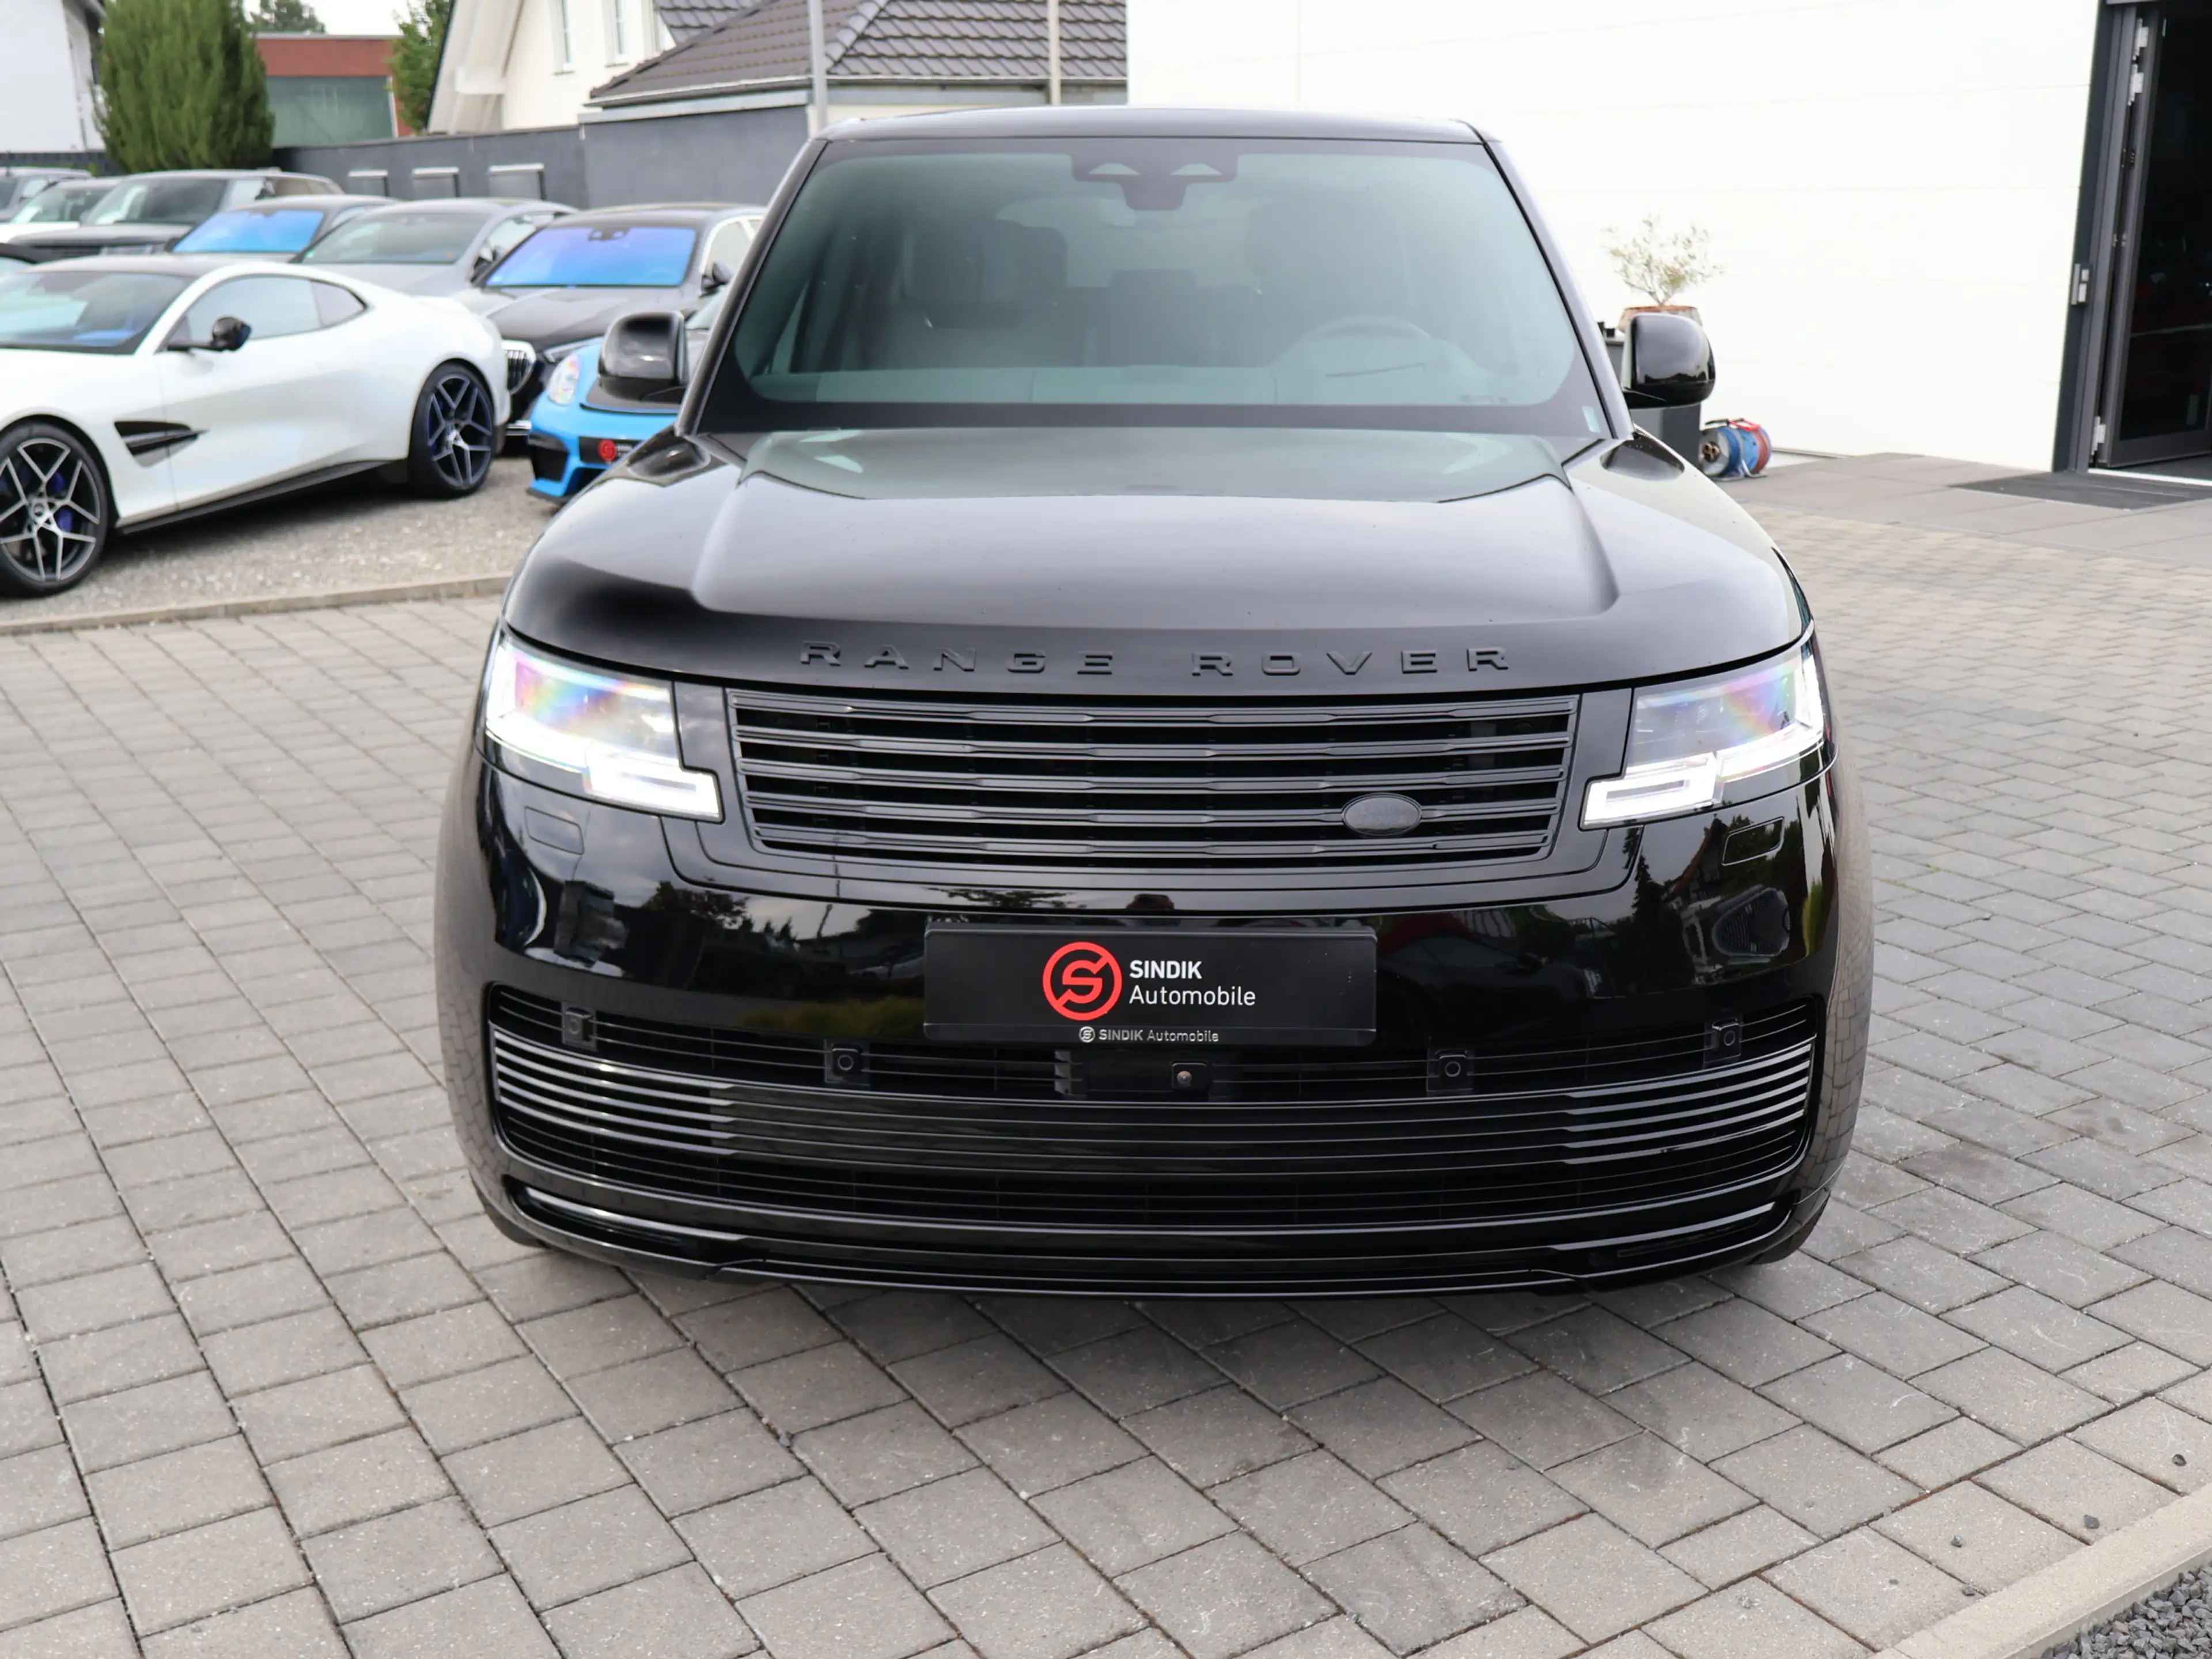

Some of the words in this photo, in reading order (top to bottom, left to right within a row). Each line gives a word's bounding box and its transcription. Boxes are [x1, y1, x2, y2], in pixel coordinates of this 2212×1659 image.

[800, 640, 1113, 675] RANGE
[1192, 647, 1509, 676] ROVER
[1129, 960, 1202, 979] SINDIK
[1128, 984, 1256, 1006] Automobile
[1099, 1029, 1143, 1041] SINDIK
[1147, 1029, 1219, 1042] Automobile
